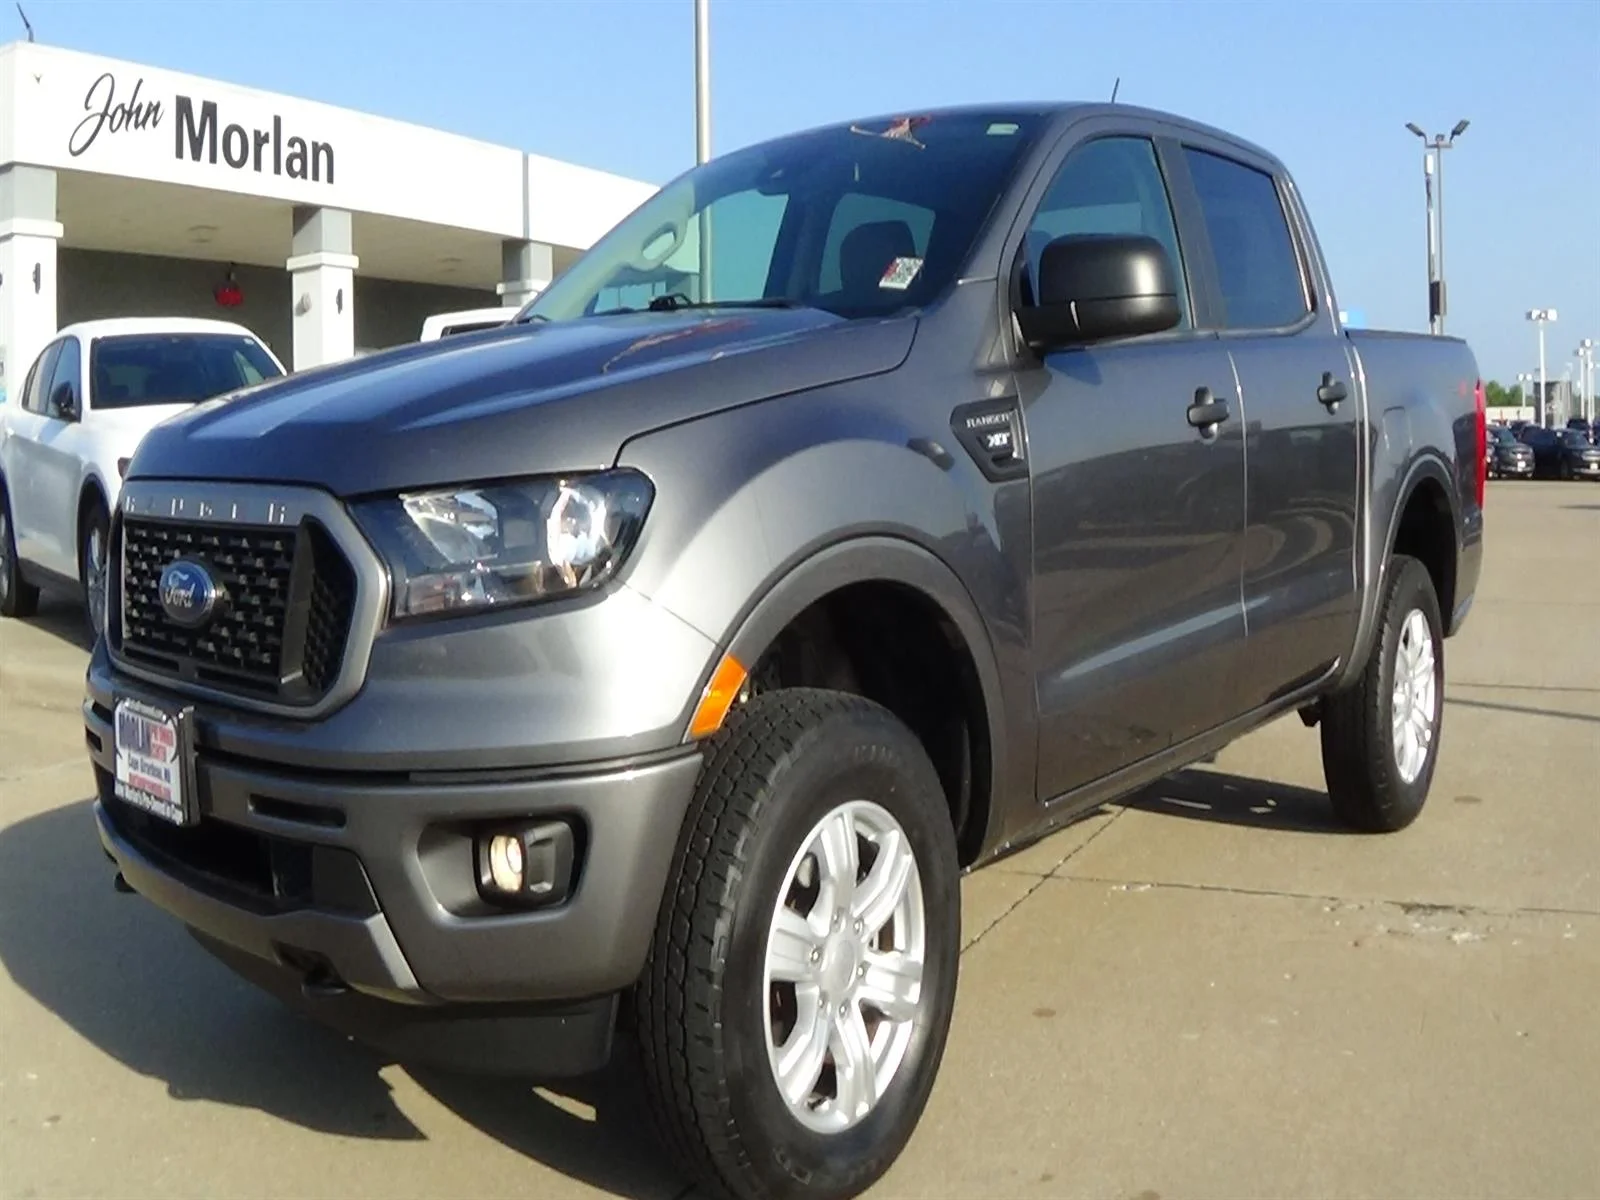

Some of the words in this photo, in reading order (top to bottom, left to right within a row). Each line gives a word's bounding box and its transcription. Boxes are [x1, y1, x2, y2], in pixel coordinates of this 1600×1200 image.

[69, 73, 164, 157] John
[175, 95, 334, 184] Morlan
[164, 570, 196, 608] Ford
